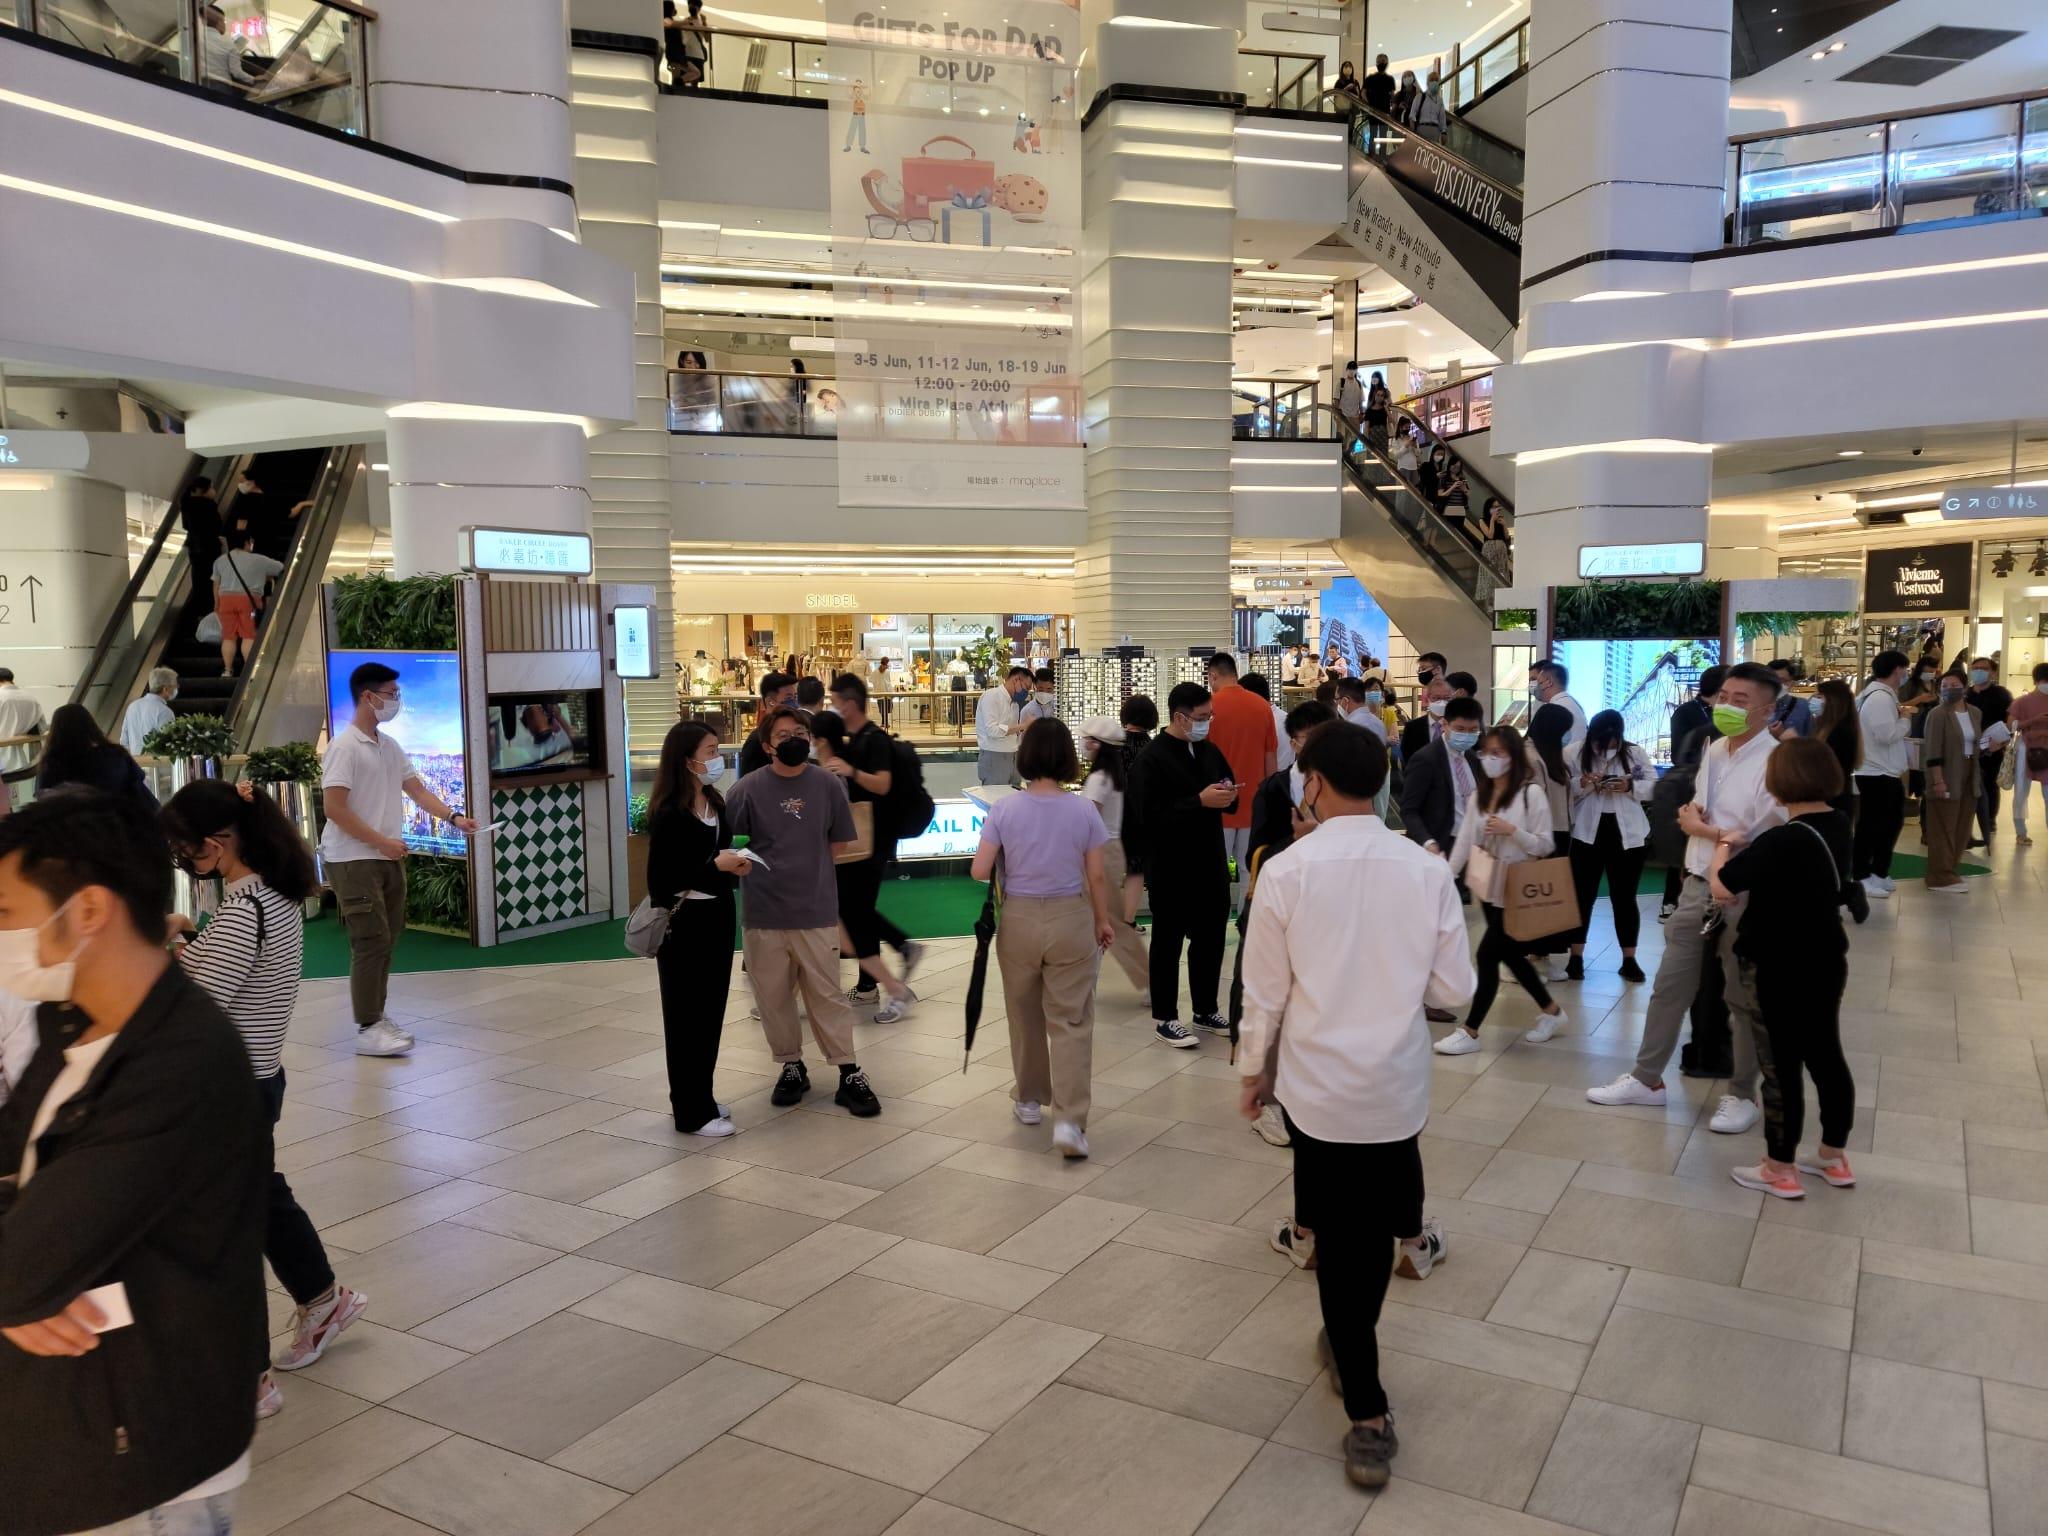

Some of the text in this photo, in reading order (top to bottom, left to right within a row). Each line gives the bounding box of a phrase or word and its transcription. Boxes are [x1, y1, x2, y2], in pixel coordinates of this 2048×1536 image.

[918, 54, 996, 83] POP UP
[1411, 236, 1441, 270] Attitude
[853, 353, 1066, 375] 3-5 Jun, 11-12 Jun, 18-19 Jun
[914, 376, 954, 391] 12:00
[971, 379, 1011, 393] 20:00
[899, 396, 1025, 413] Mira Place Atri
[1945, 497, 1961, 511] G
[1898, 566, 1940, 582] Vivienne
[1893, 578, 1944, 596] Westwood
[807, 594, 857, 607] SNIDEL
[1904, 599, 1930, 607] LONDON
[1522, 882, 1553, 898] GU
